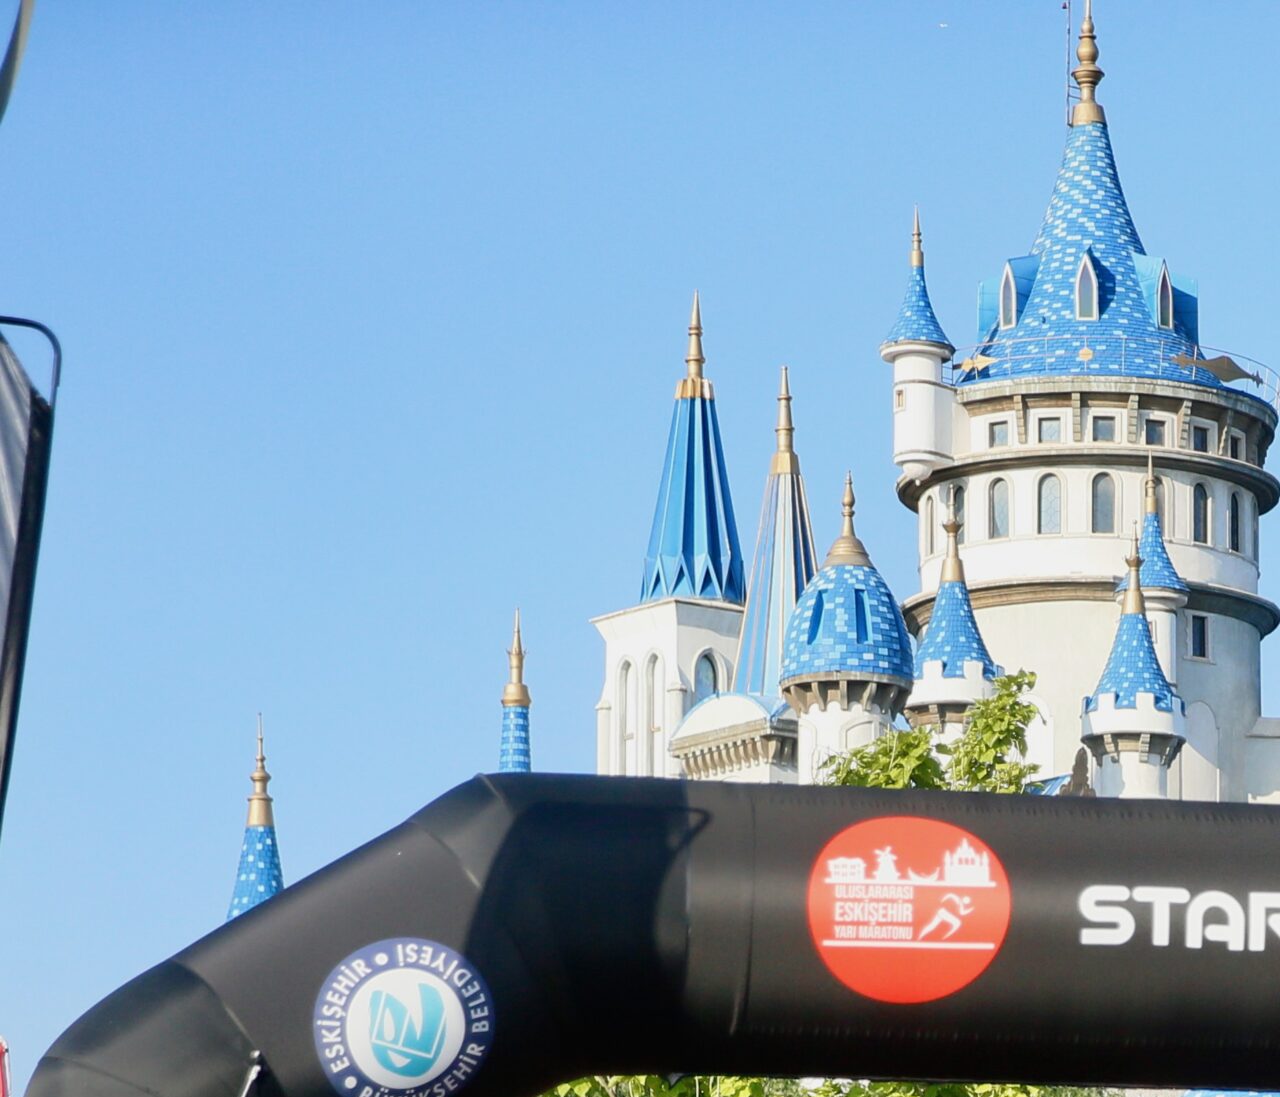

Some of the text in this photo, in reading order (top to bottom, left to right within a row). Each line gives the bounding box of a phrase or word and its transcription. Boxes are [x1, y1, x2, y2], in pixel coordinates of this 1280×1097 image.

[834, 884, 914, 900] ULUSLARARASI
[833, 900, 914, 925] ESKİŞEHİR
[833, 925, 914, 940] YARI MARATONU
[396, 943, 490, 1033] BELEDİYESİ
[317, 958, 373, 1073] ESKİŞEHİR
